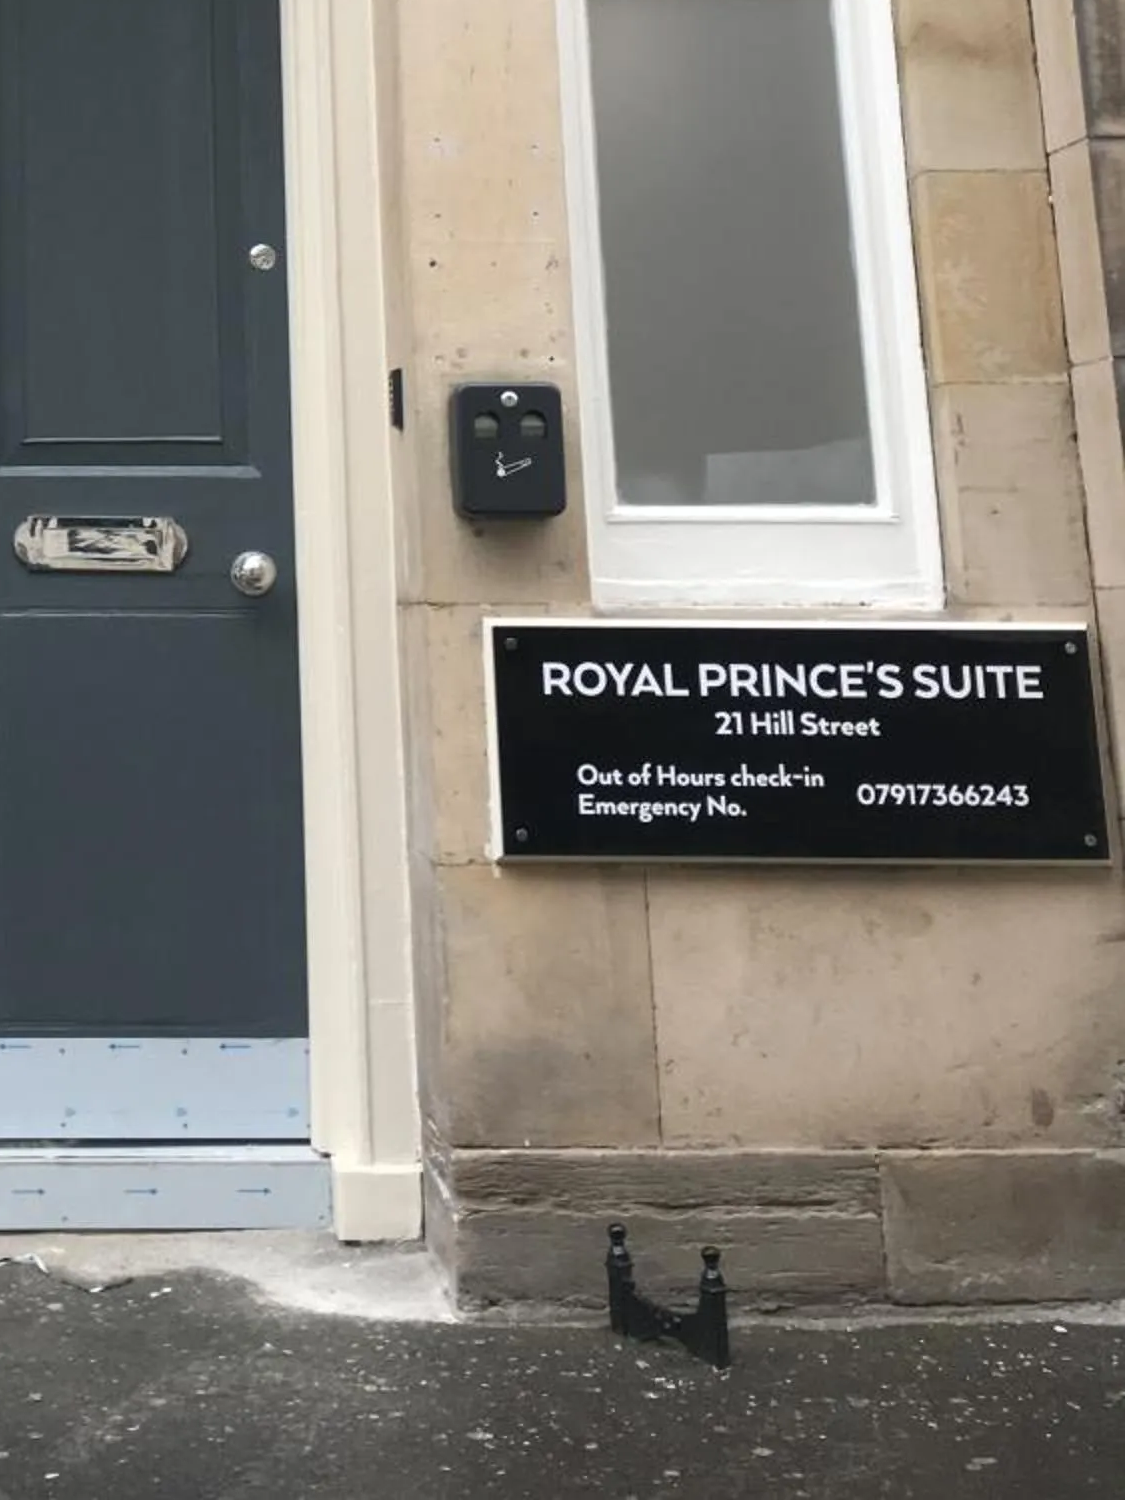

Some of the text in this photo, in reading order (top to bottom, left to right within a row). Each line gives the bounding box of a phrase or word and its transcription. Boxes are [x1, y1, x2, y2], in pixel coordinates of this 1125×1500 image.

[542, 660, 1044, 699] ROYAL PRINCE'S SUITE
[714, 709, 881, 737] 21 Hill Street
[576, 762, 825, 787] Out of Hours check-in
[578, 793, 748, 823] Emergency No.
[856, 783, 1030, 807] 07917366243
